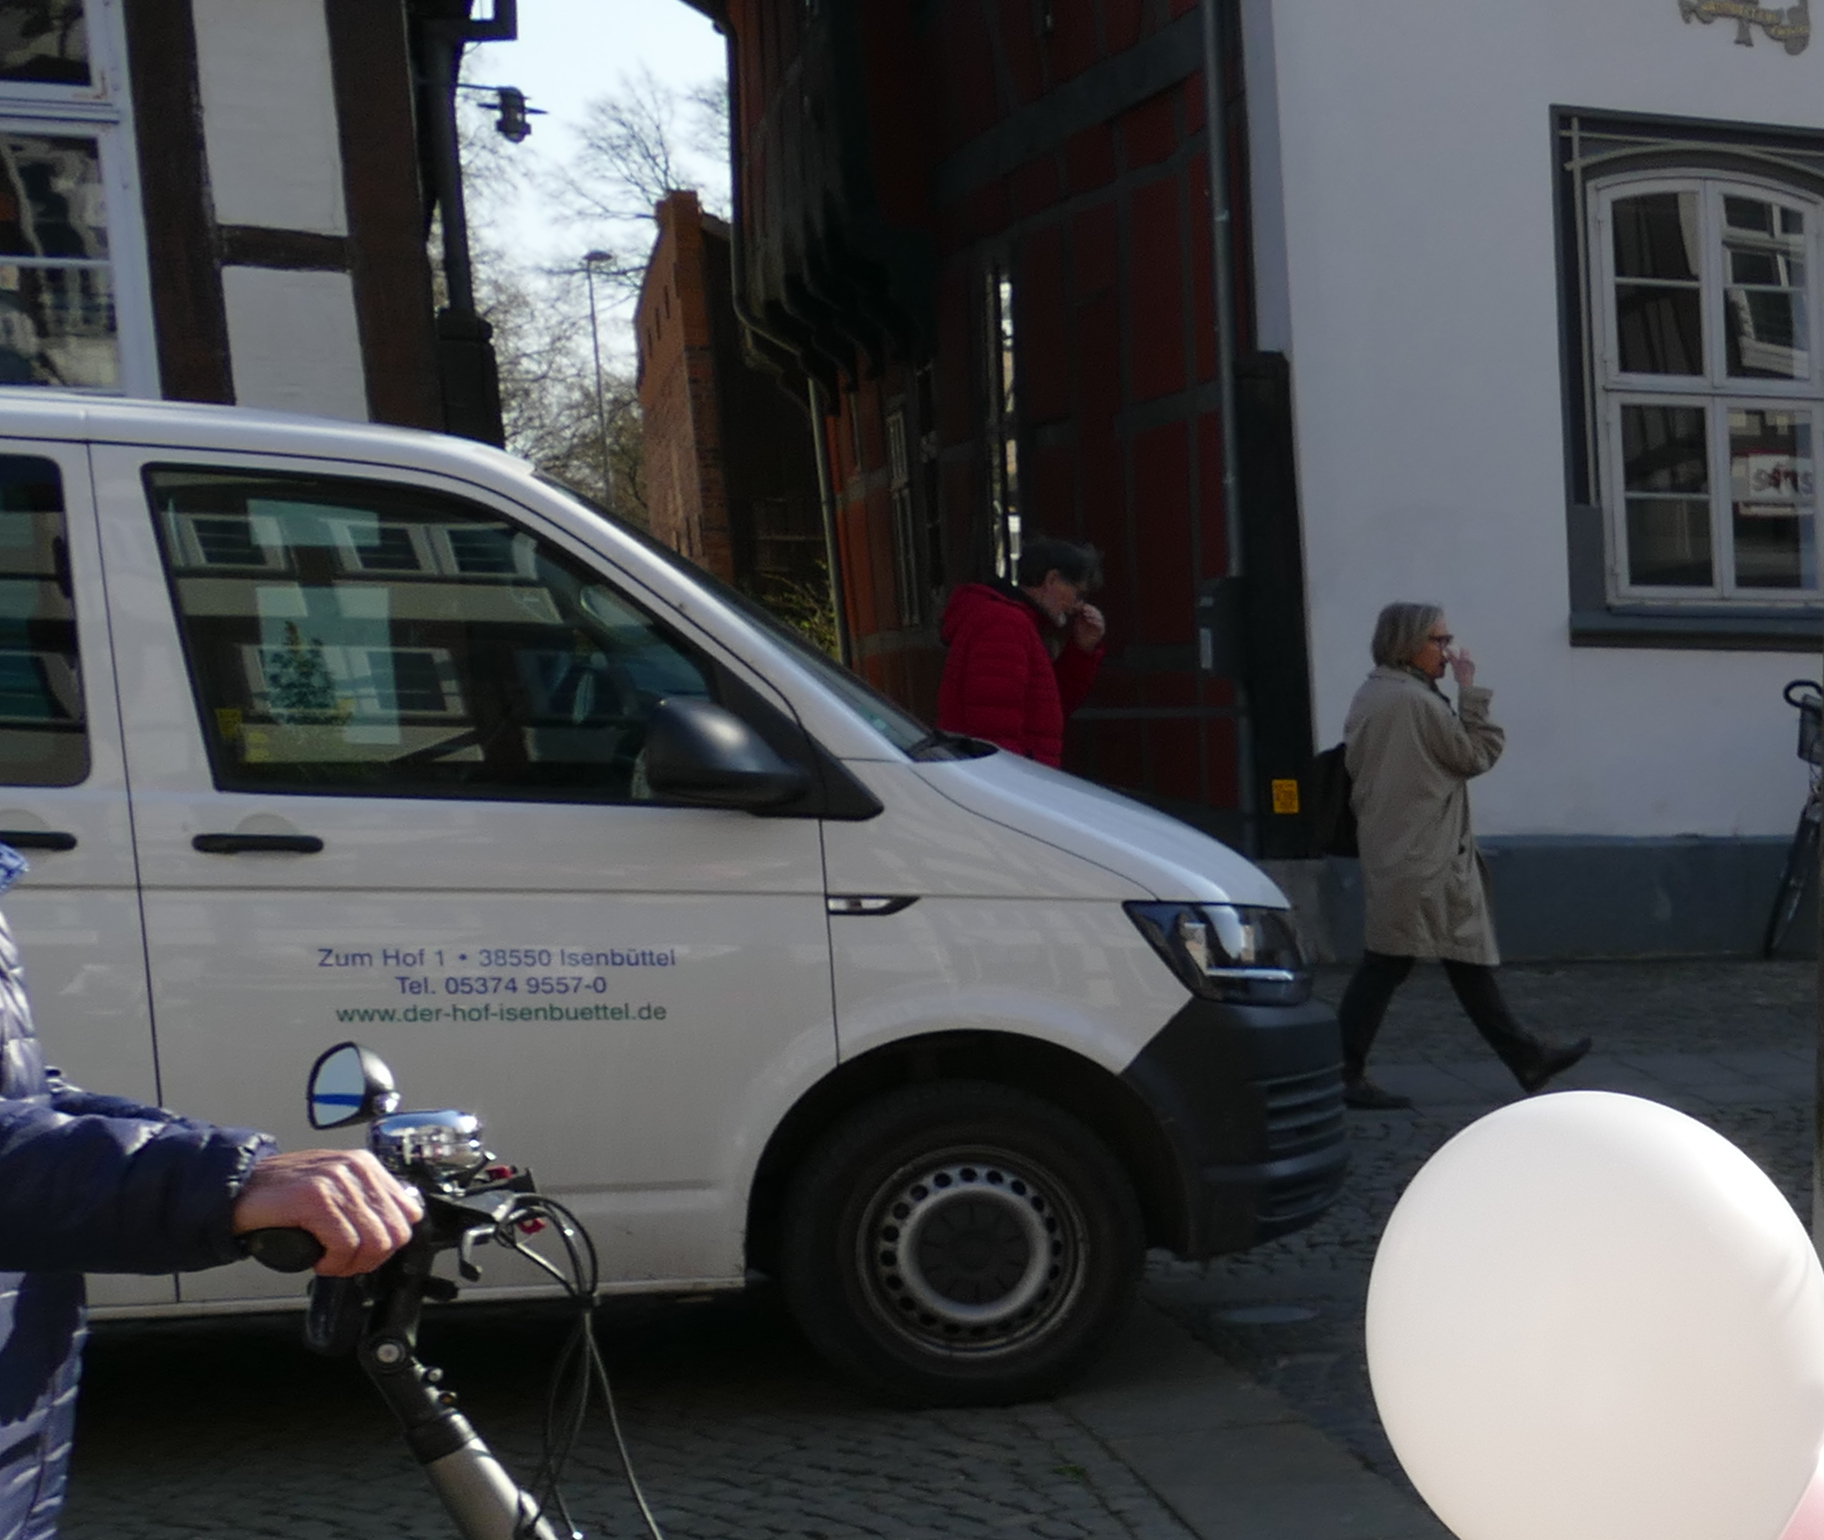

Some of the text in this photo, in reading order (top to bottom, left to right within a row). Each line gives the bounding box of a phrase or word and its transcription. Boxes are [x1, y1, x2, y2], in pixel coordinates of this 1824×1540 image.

[318, 948, 676, 967] Zum Hof 1 38550 Isenbüttel
[396, 976, 607, 995] Tel. 05374 9557-0
[336, 1003, 667, 1022] www.der-hof-isenbuettel.de
